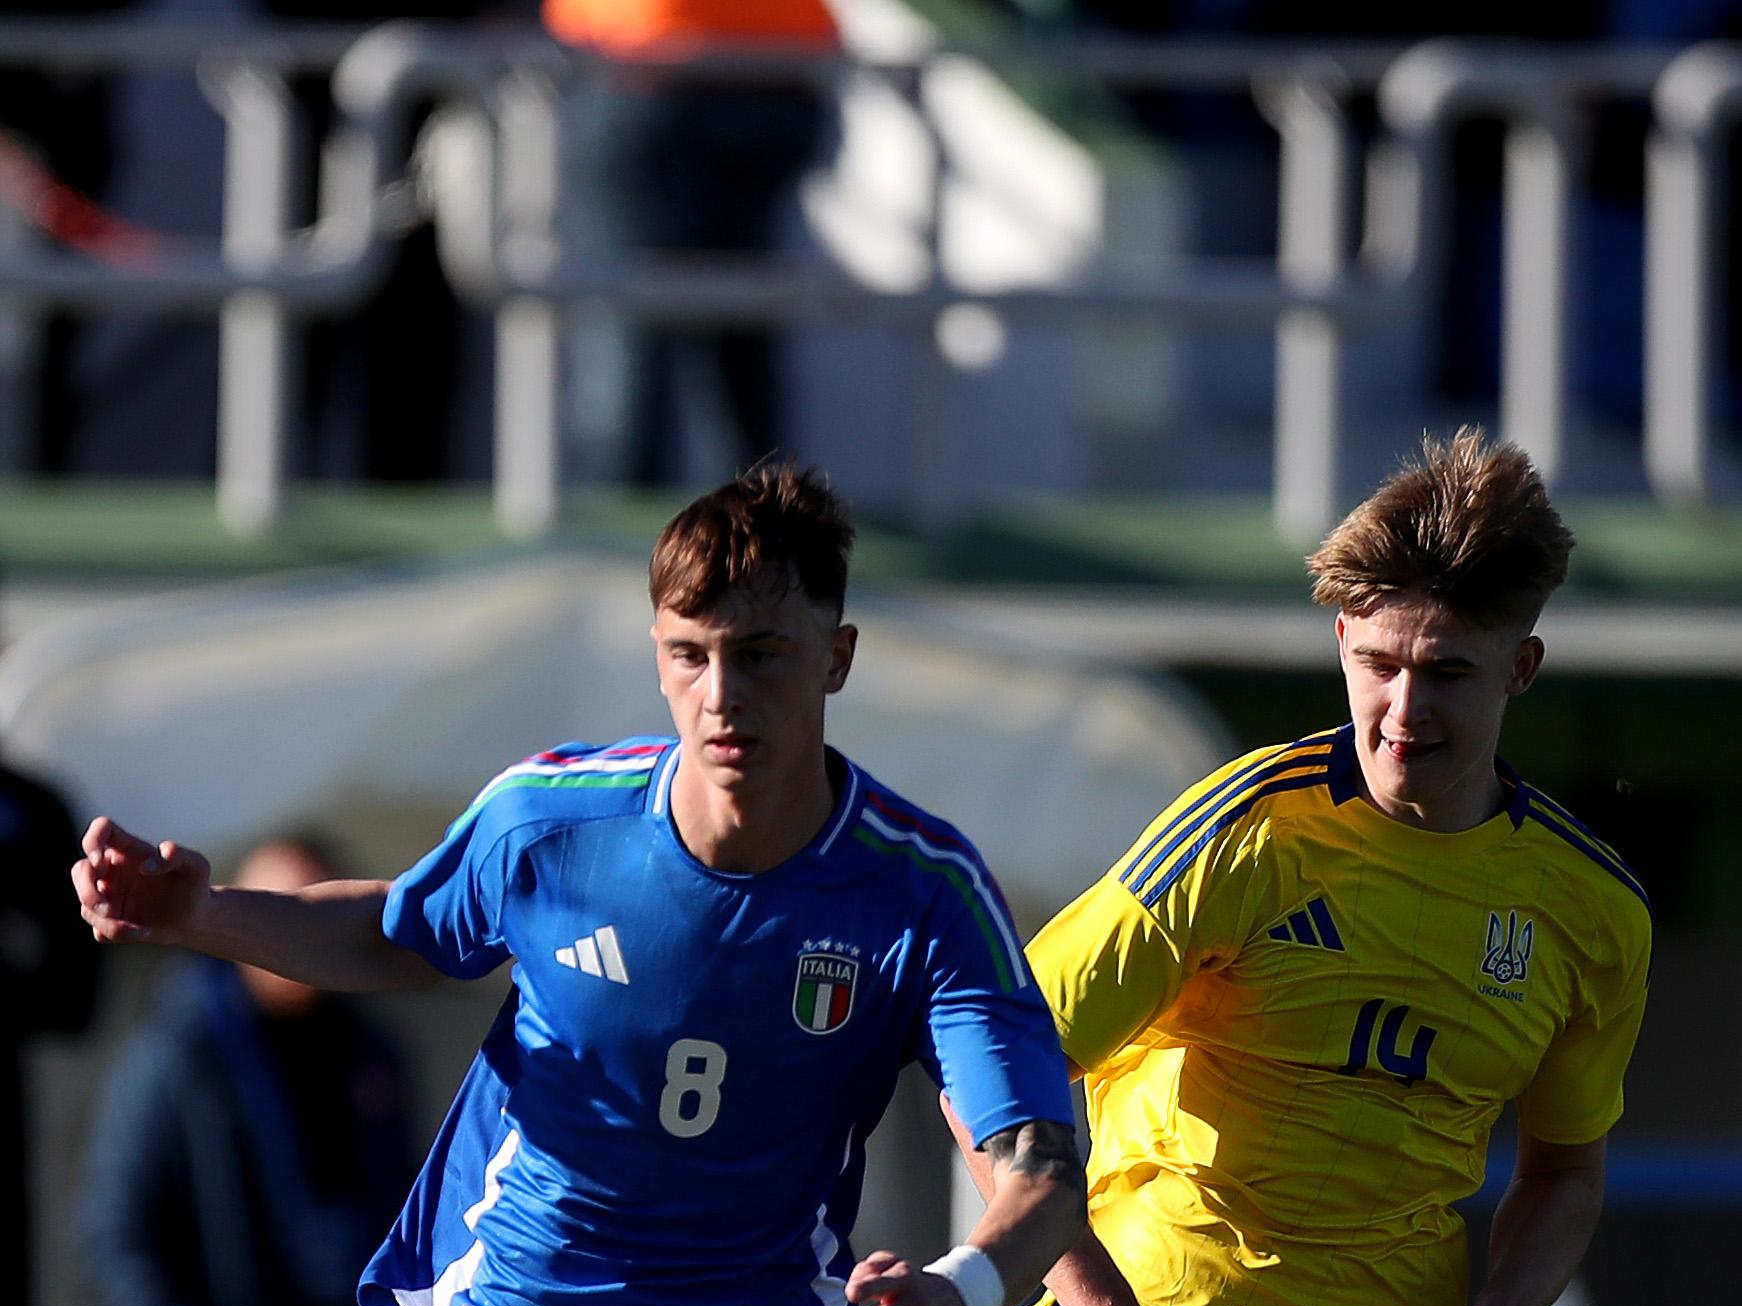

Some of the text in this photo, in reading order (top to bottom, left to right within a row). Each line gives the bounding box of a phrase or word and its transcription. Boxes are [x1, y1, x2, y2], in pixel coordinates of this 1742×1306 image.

[802, 958, 852, 981] ITALIA
[1477, 984, 1525, 1002] UKRAINE
[1337, 998, 1438, 1088] 14
[659, 1038, 727, 1138] 8
